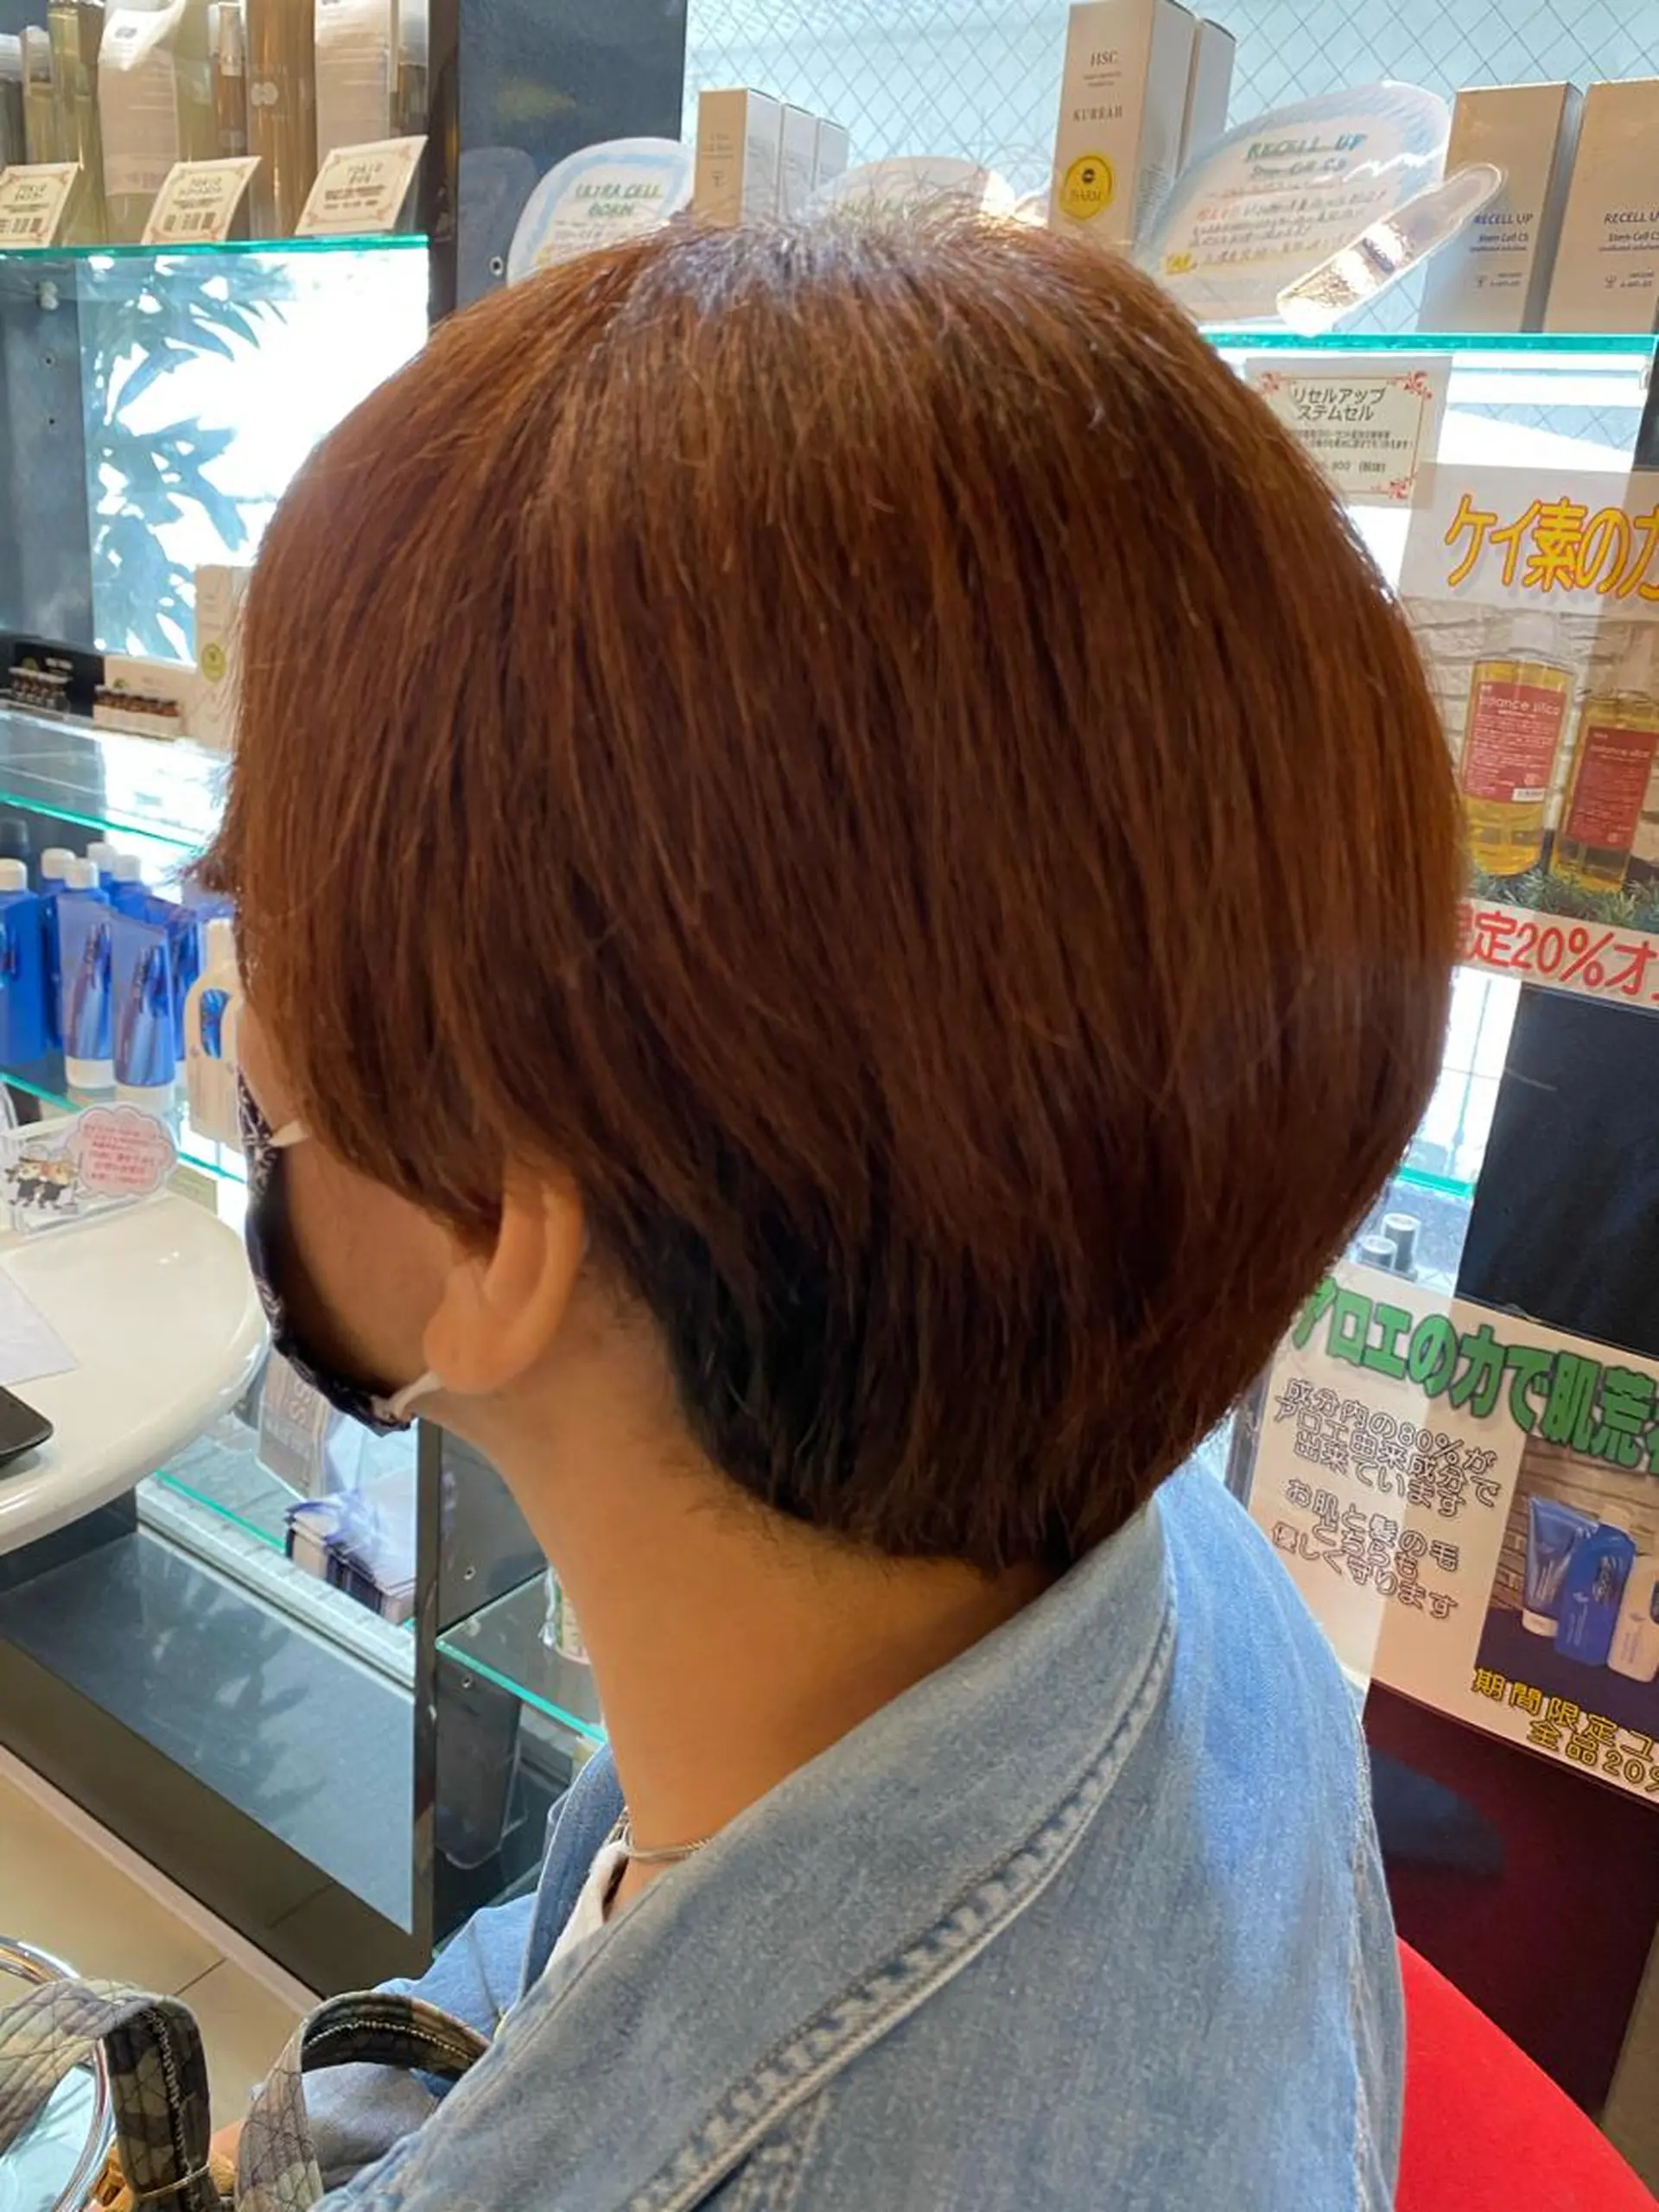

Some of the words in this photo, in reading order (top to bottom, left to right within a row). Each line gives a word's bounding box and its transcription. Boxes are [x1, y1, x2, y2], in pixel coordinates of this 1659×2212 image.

[1604, 213, 1646, 225] RECELL
[1297, 404, 1375, 422] ステムセル
[1456, 904, 1659, 1001] 定20%オ
